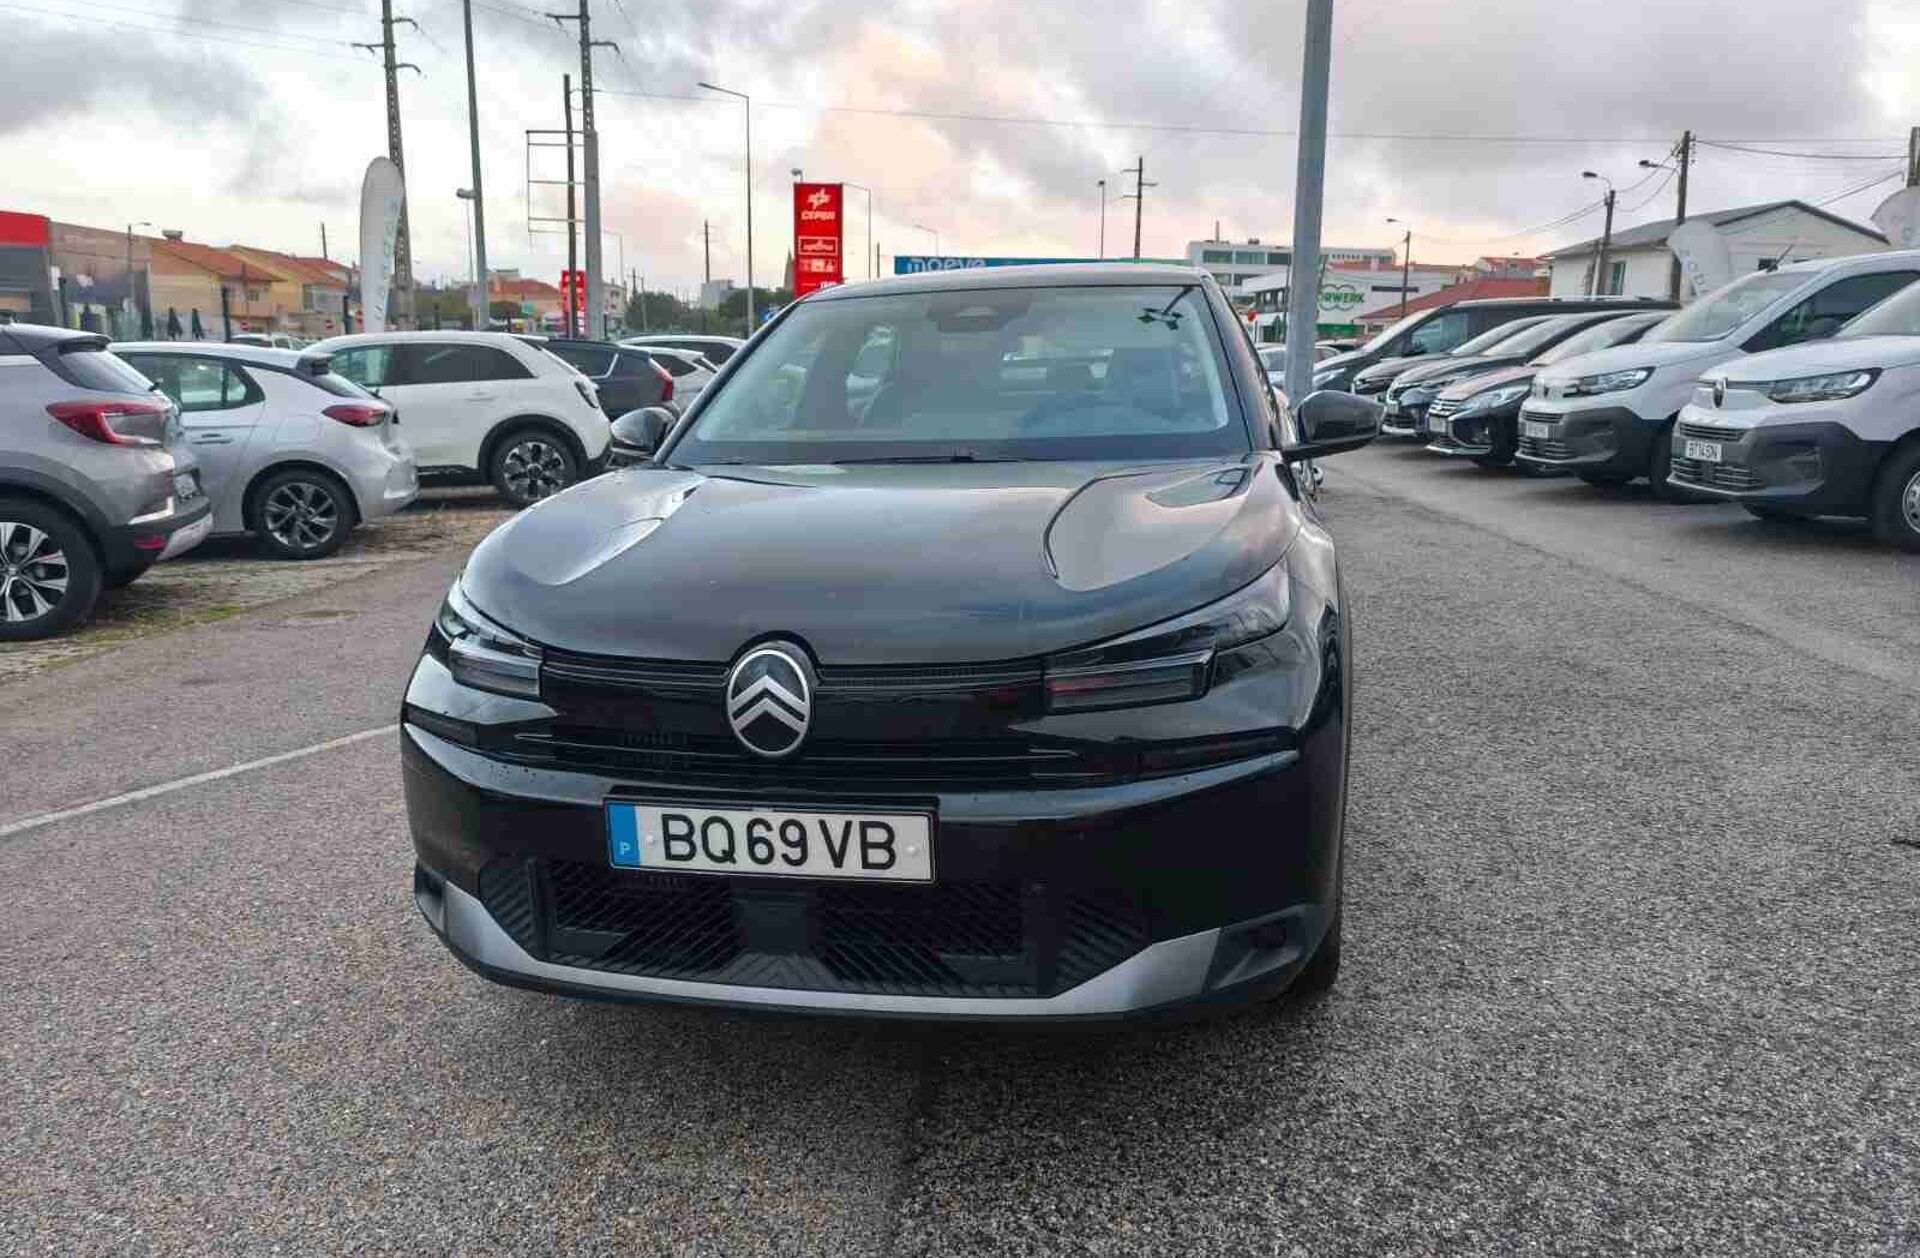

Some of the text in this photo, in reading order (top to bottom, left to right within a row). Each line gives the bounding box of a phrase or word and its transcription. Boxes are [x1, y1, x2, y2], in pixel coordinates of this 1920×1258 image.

[1318, 292, 1365, 303] ORWERK
[619, 842, 630, 855] P
[661, 813, 897, 871] BQ 69 VB
